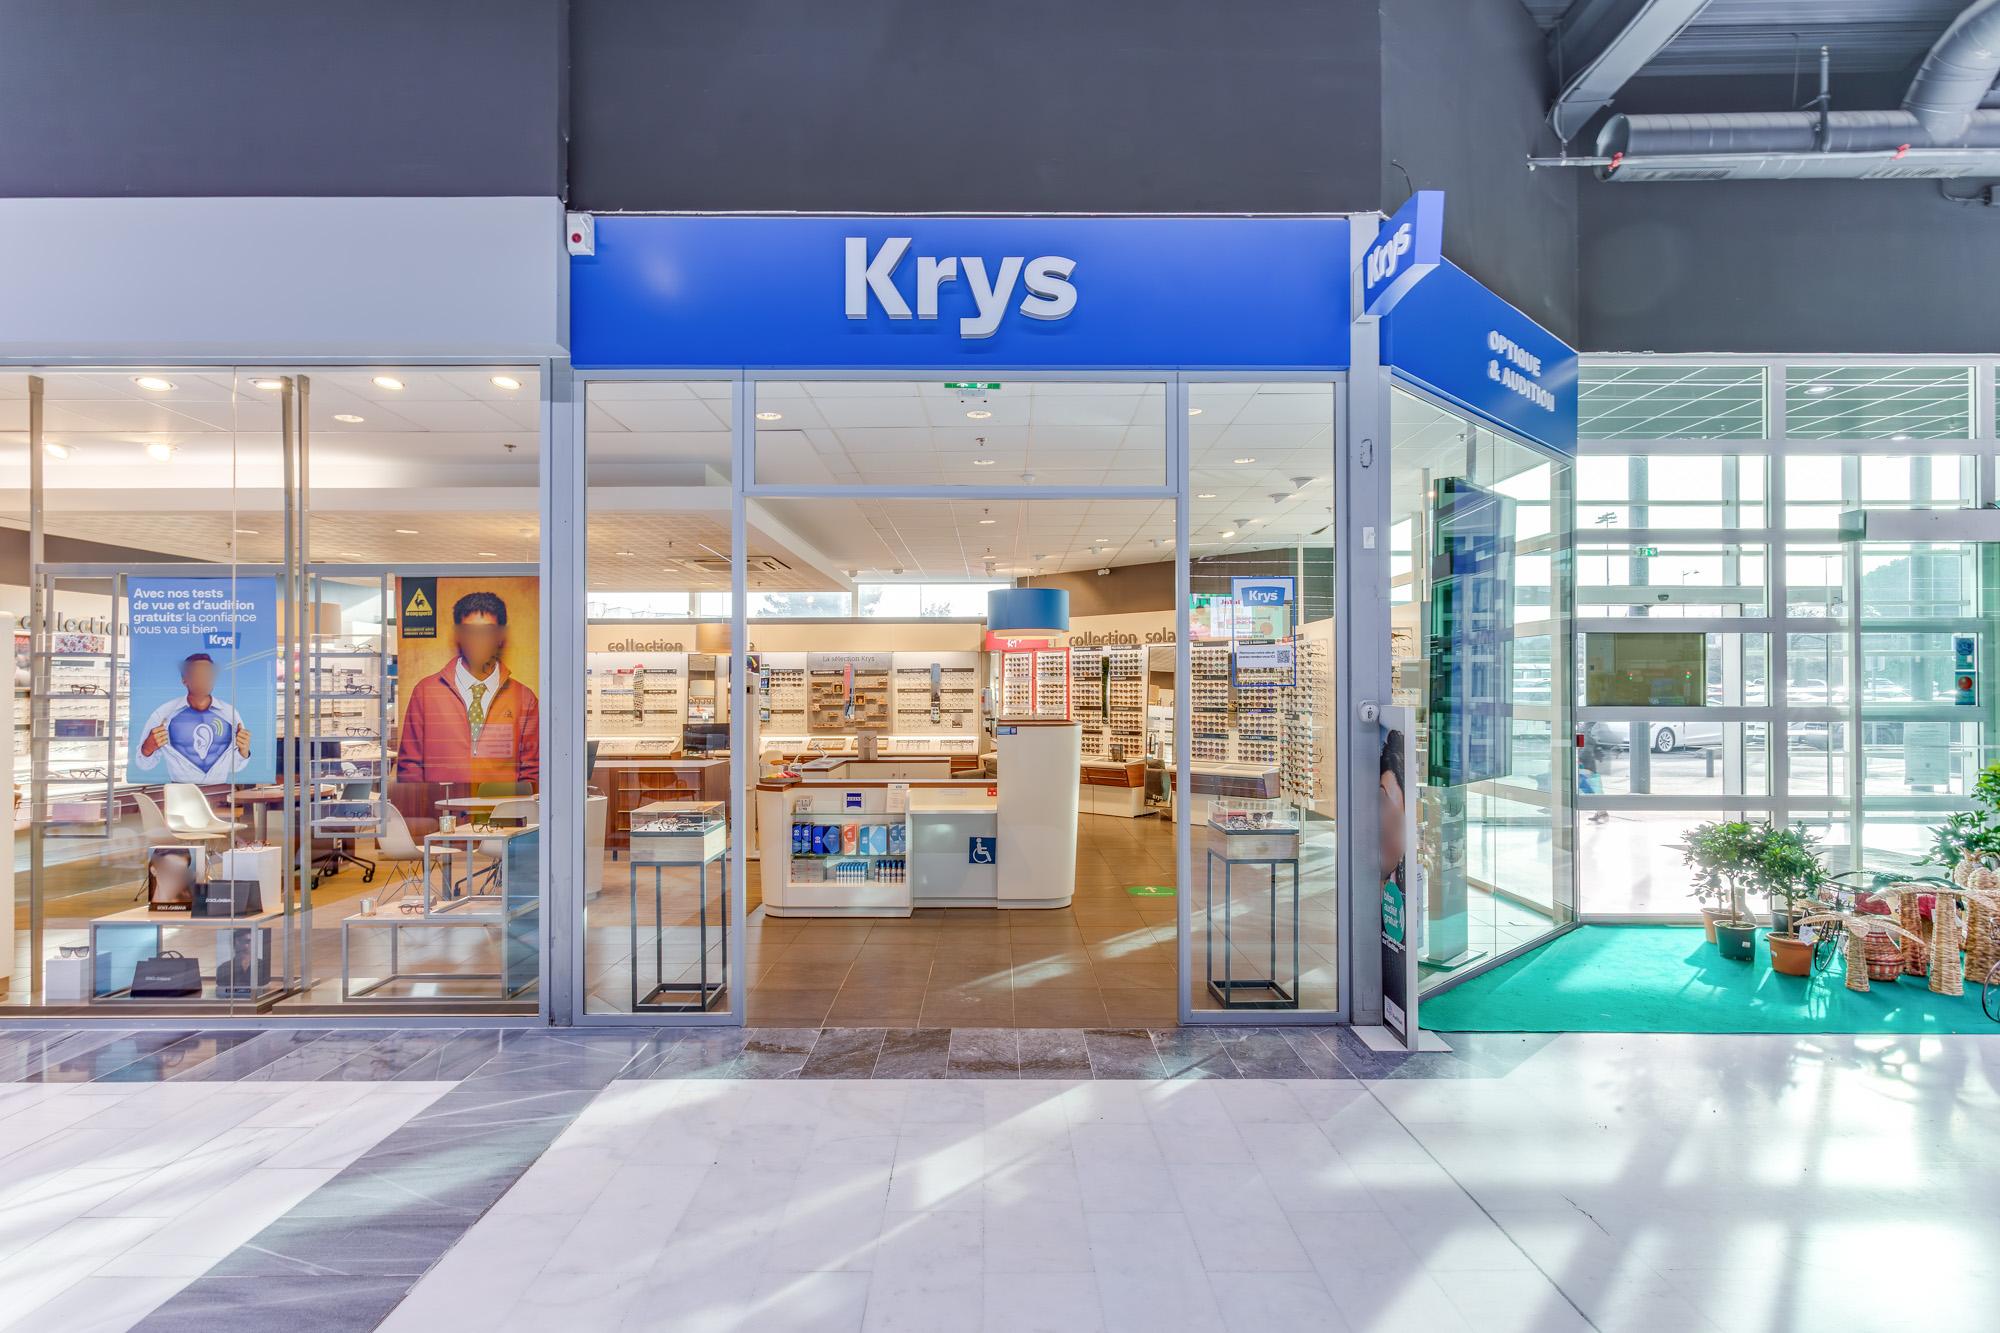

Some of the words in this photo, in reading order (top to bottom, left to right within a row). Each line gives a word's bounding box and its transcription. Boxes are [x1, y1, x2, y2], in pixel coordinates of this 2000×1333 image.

[1367, 222, 1413, 289] Krys
[844, 236, 1078, 340] Krys
[1488, 330, 1541, 377] OPTIQUE
[1488, 359, 1501, 381] &
[1501, 366, 1555, 412] AUDITION
[133, 587, 165, 599] Avec
[167, 589, 190, 599] nos
[192, 588, 224, 599] tests
[1248, 589, 1279, 603] Krys
[133, 600, 149, 610] de
[151, 602, 174, 610] vue
[177, 600, 191, 610] et
[193, 600, 255, 610] d'audition
[186, 611, 197, 622] la
[199, 611, 257, 622] confiance
[20, 612, 129, 636] clection
[133, 625, 162, 635] vous
[163, 625, 179, 635] va
[180, 624, 191, 635] si
[192, 624, 219, 635] bien
[208, 634, 234, 647] Krys
[1069, 629, 1138, 647] collection
[1145, 626, 1176, 644] sola
[607, 638, 684, 652] collection
[861, 655, 876, 664] Krys
